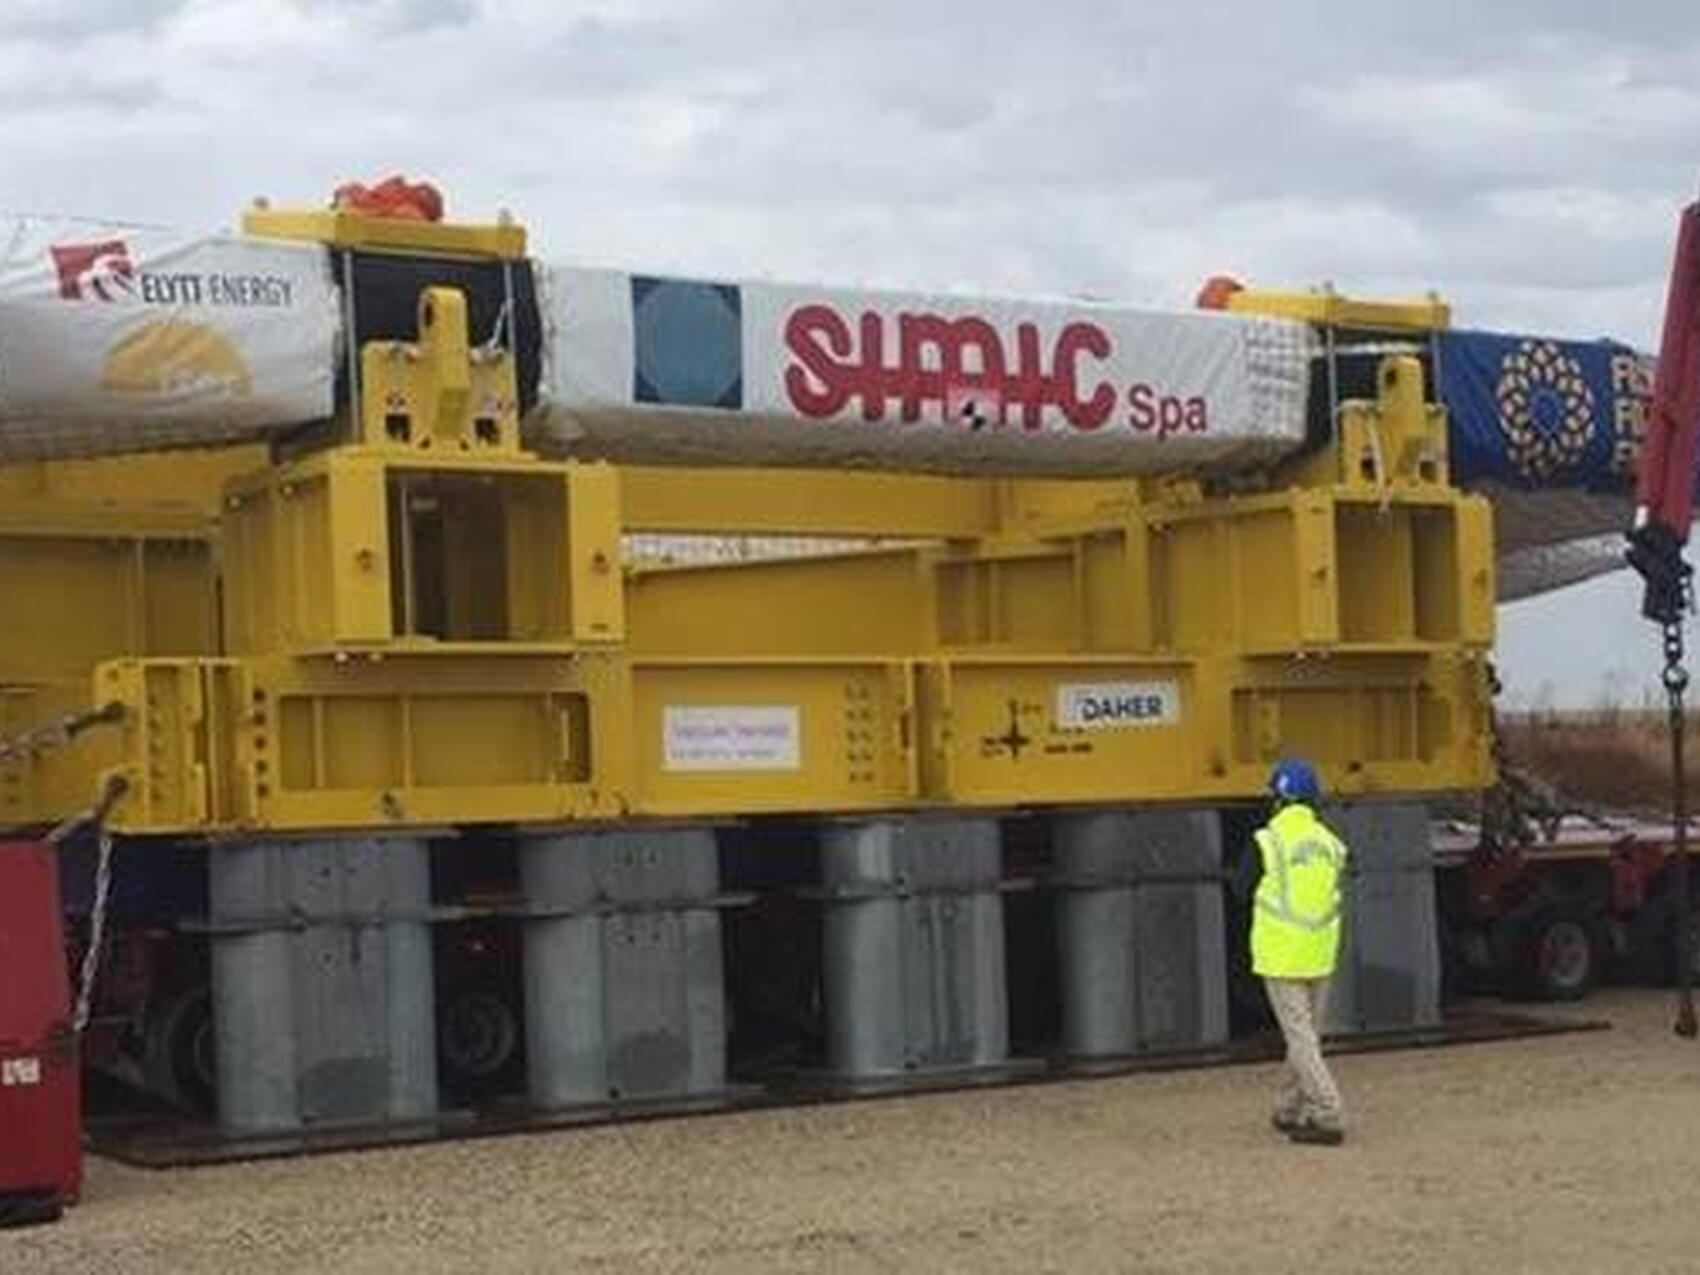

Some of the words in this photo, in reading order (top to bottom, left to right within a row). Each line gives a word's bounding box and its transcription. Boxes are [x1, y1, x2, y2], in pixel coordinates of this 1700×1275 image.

[209, 274, 292, 307] ENERGY
[1128, 383, 1208, 441] Spa
[1082, 696, 1163, 721] DAHER
